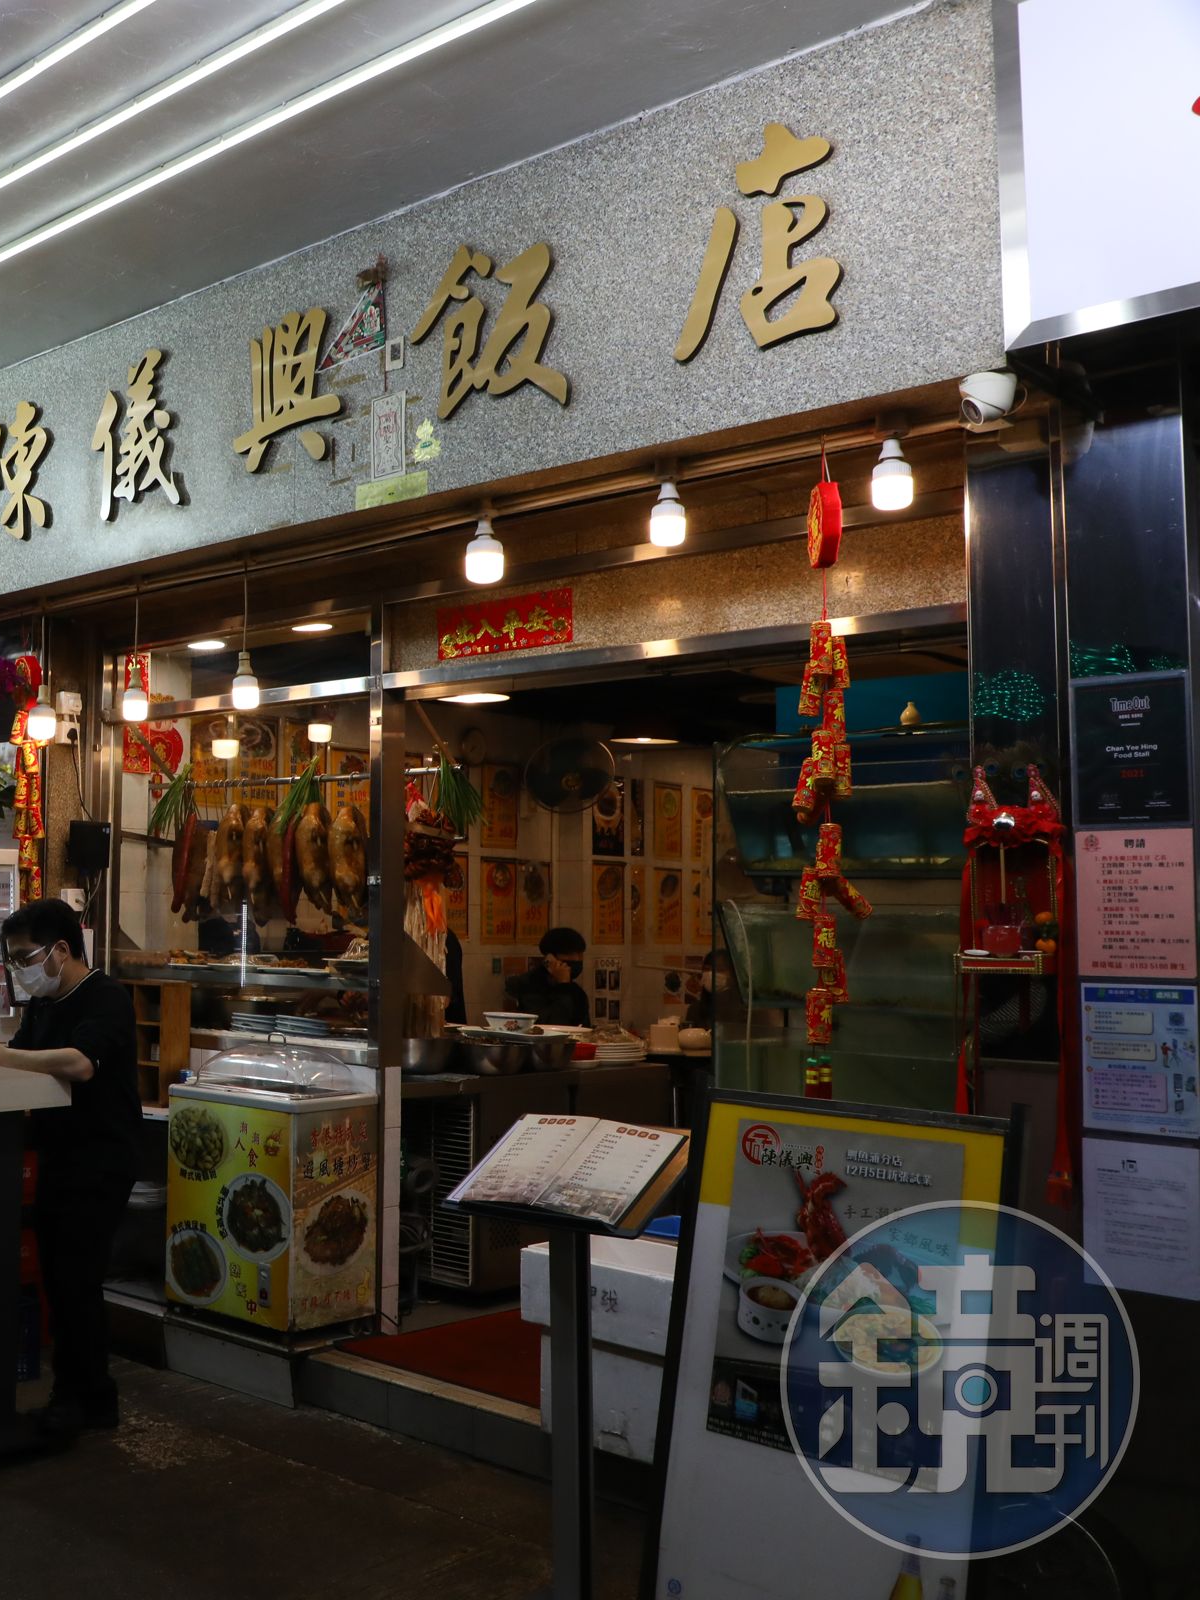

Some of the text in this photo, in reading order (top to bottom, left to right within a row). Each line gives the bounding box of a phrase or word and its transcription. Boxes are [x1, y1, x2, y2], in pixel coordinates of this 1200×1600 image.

[1106, 745, 1124, 753] Chan
[1141, 743, 1158, 751] Hing
[1124, 838, 1146, 849] 聘請
